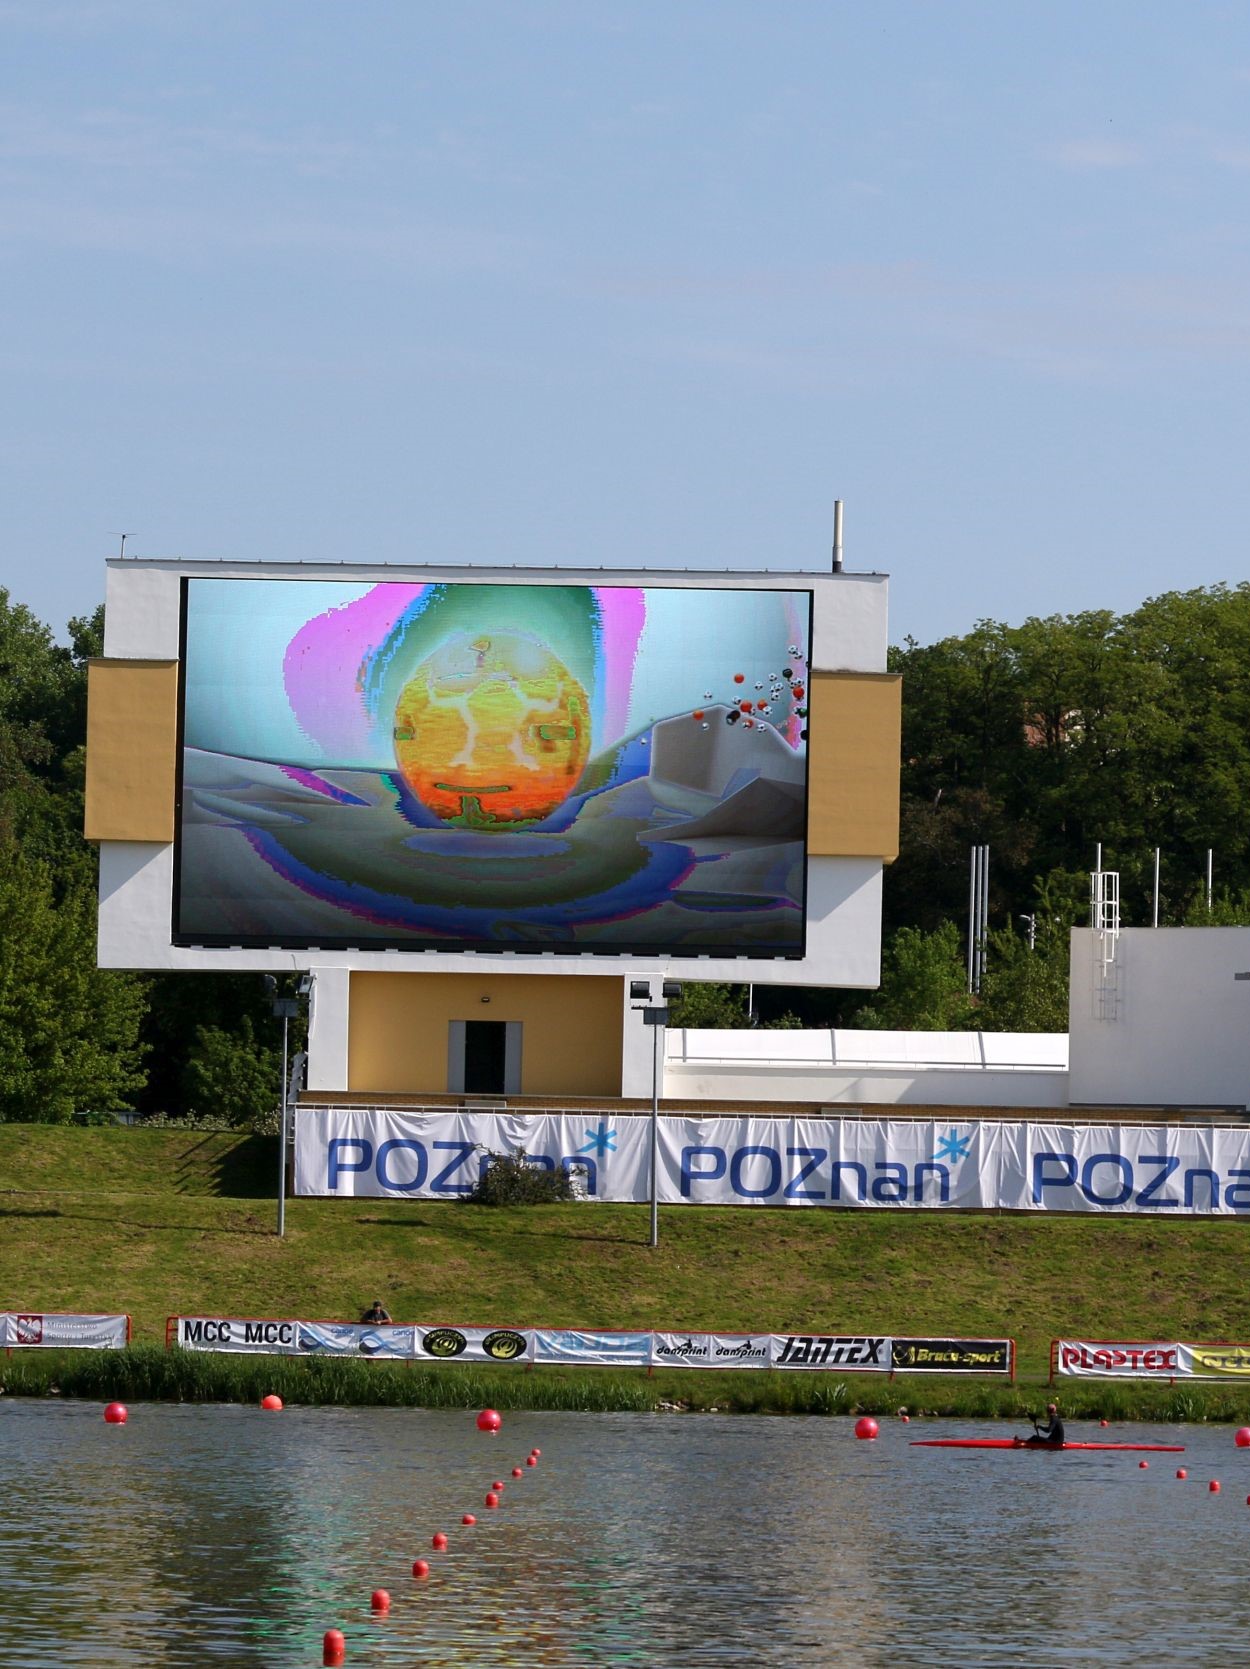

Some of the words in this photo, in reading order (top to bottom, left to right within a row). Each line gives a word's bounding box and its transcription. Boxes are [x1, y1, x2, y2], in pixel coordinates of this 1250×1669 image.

[185, 1321, 232, 1342] MCC
[245, 1323, 292, 1343] MCC
[656, 1345, 708, 1357] dansprint
[715, 1345, 766, 1358] dansprint
